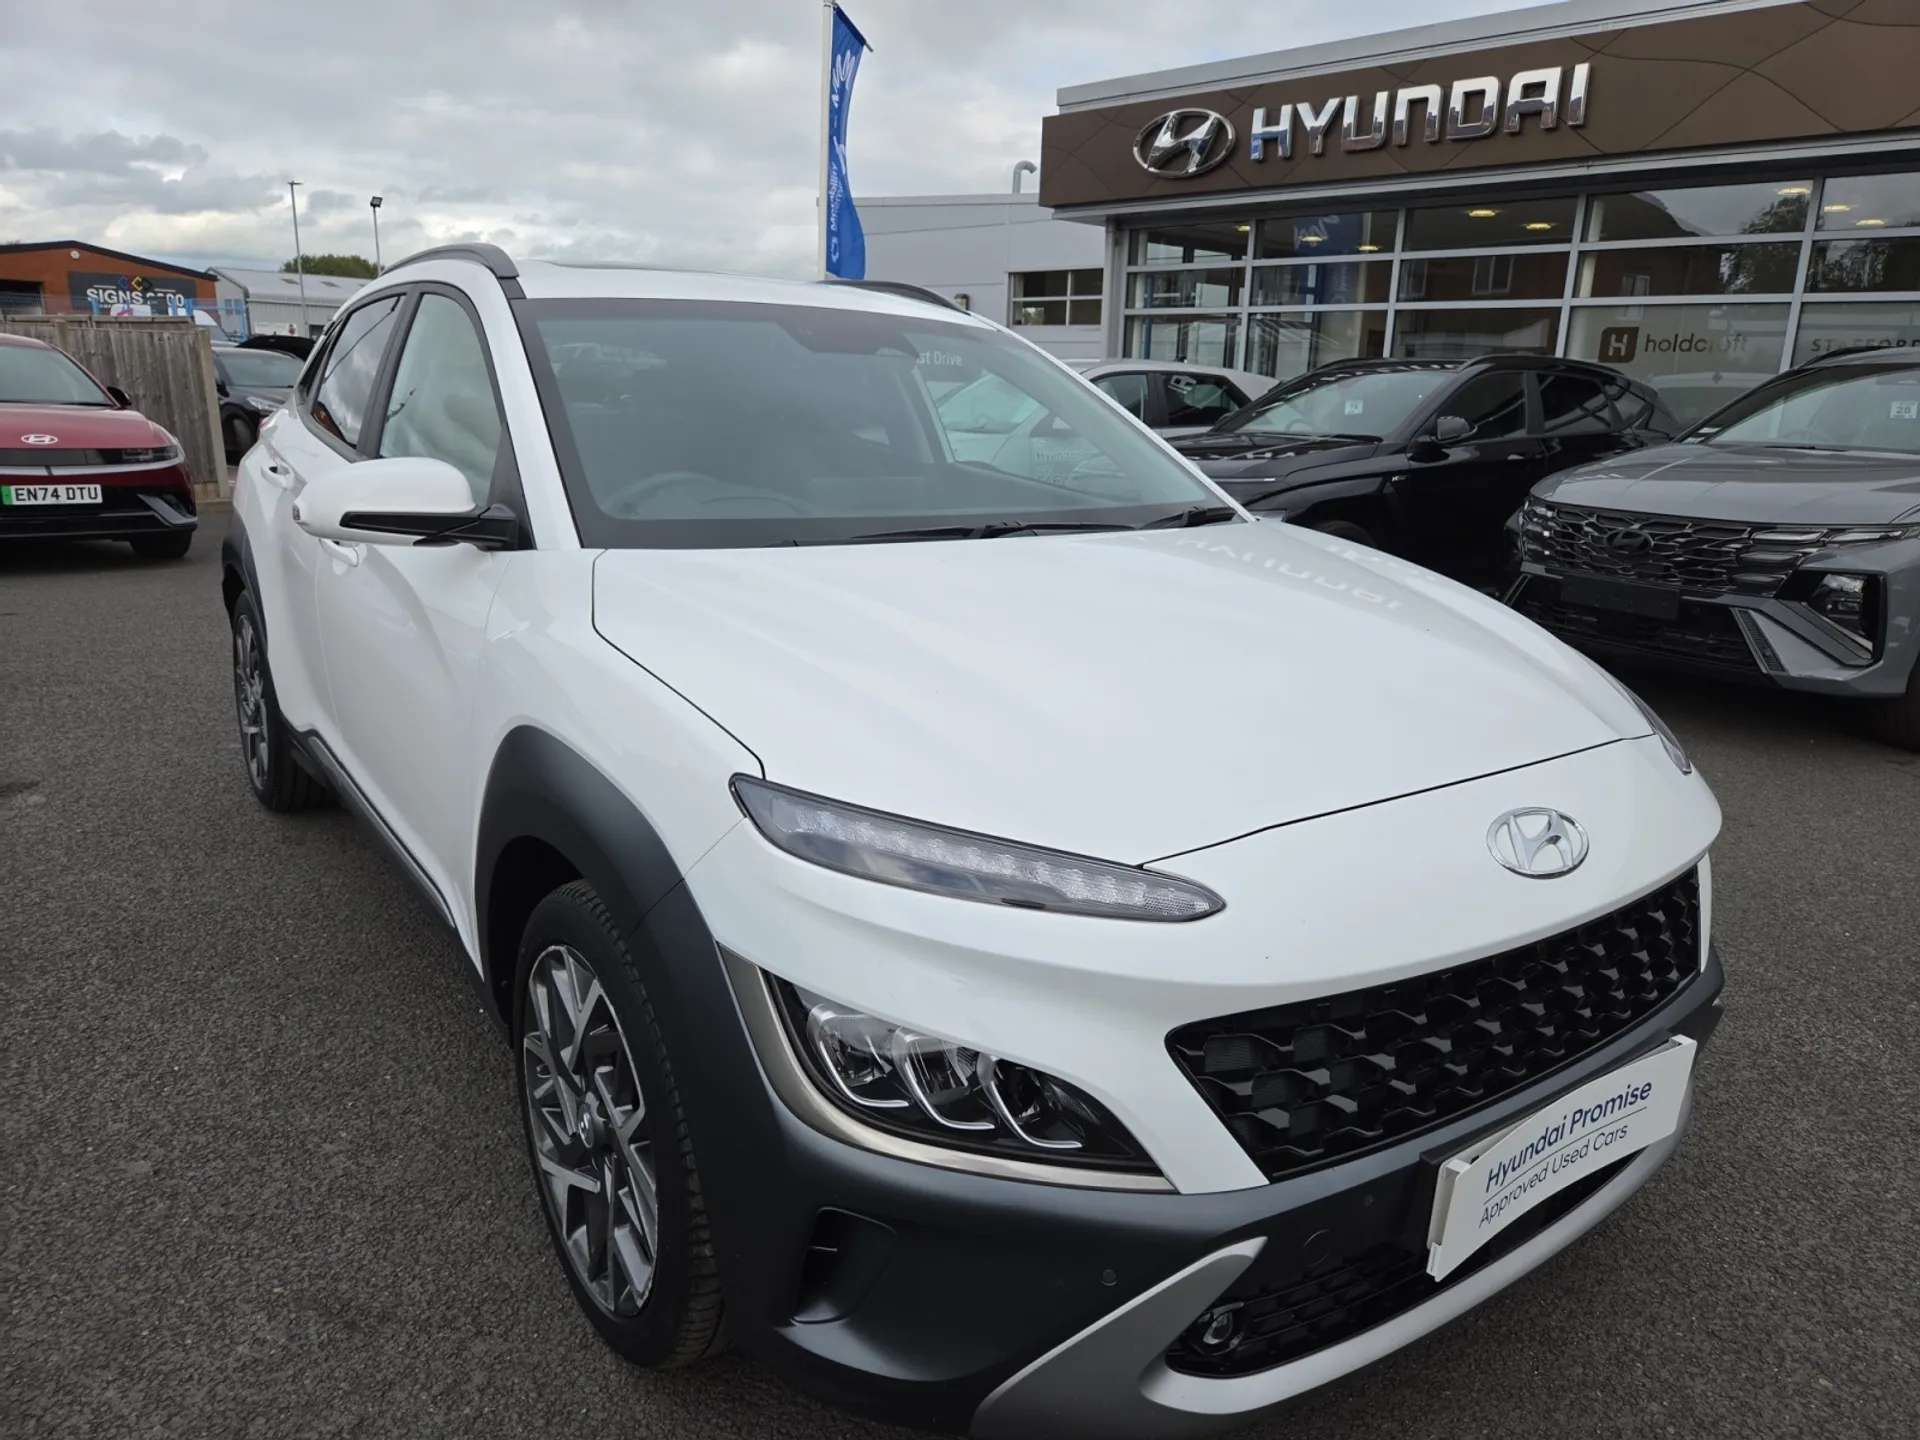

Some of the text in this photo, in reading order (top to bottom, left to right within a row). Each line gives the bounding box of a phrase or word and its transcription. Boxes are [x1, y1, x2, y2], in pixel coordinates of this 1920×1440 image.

[1250, 62, 1592, 160] HYUNDAI
[86, 288, 143, 305] SIGNS
[15, 486, 98, 501] EN74 DTU
[1478, 1124, 1628, 1228] Approved Used Cars
[1486, 1082, 1652, 1193] Hyundai Promise
